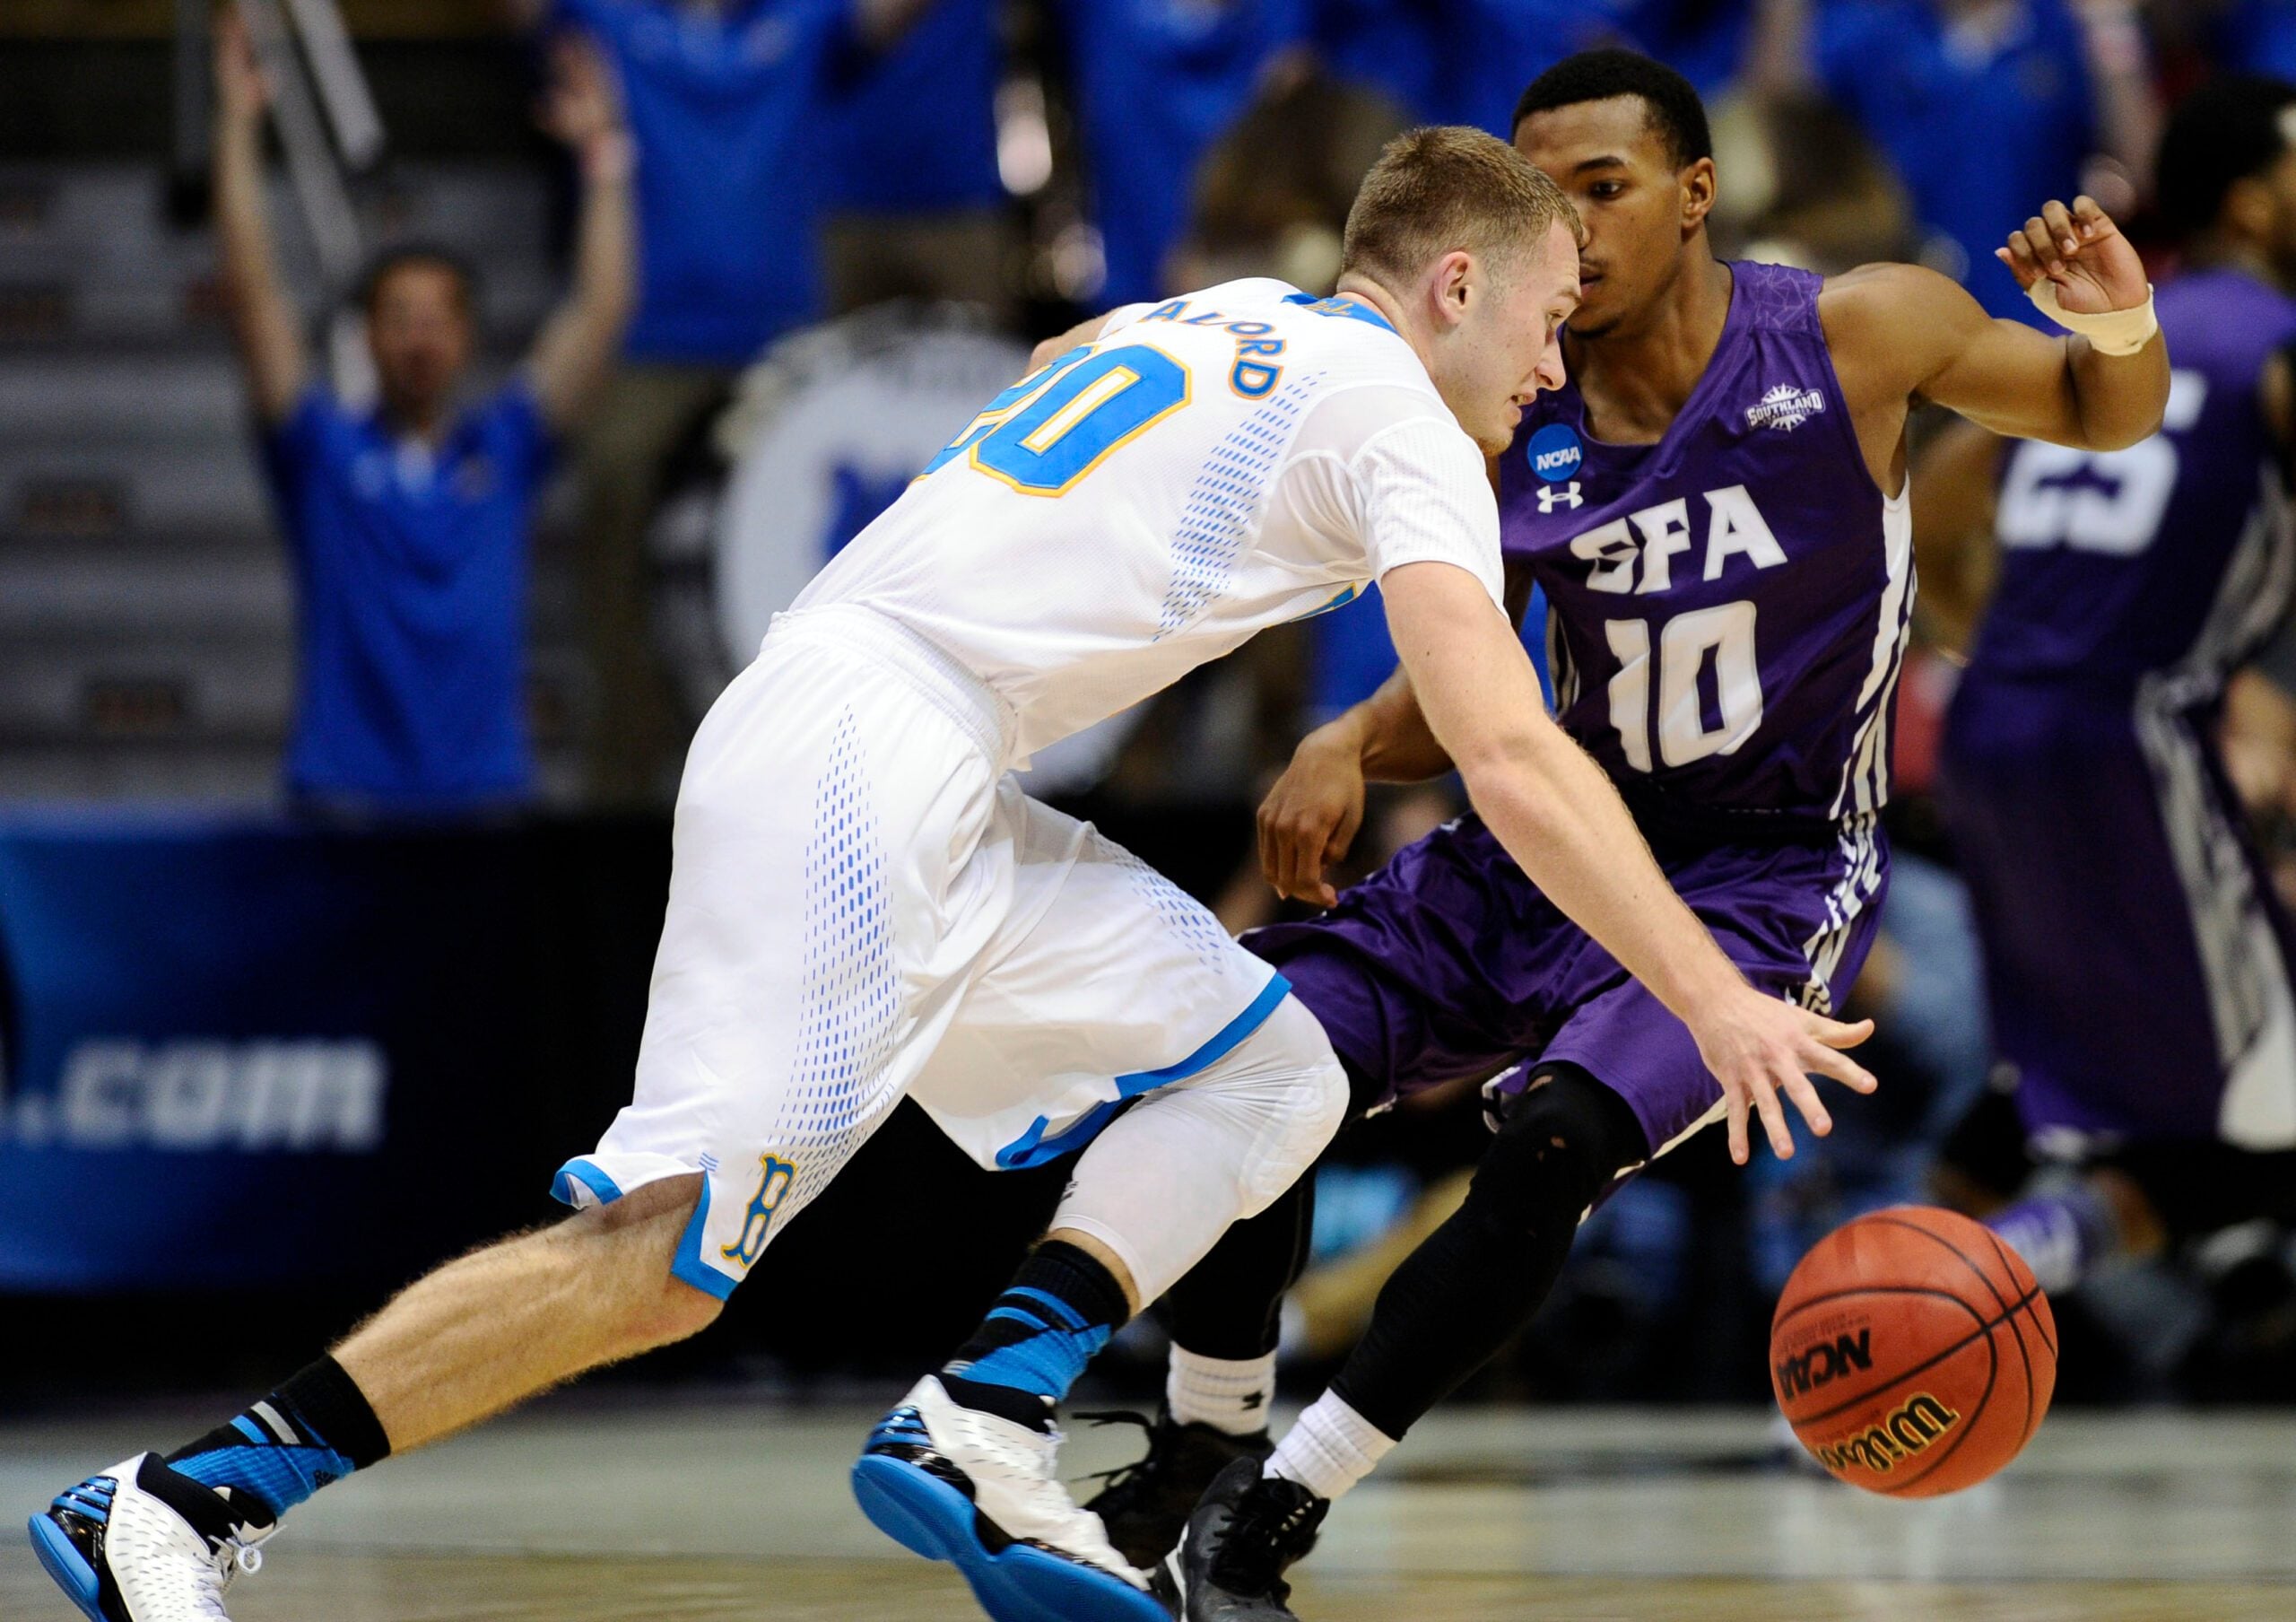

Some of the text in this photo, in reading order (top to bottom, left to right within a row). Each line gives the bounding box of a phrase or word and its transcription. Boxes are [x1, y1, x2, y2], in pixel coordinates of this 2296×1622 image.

[1747, 392, 1823, 426] SOUTHLAND
[1536, 446, 1581, 471] NCAA
[1570, 484, 1787, 595] SFA
[1605, 600, 1763, 772] 10
[721, 1153, 796, 1269] B
[1777, 1328, 1873, 1401] NCAA
[1812, 1392, 1961, 1473] Wilso
